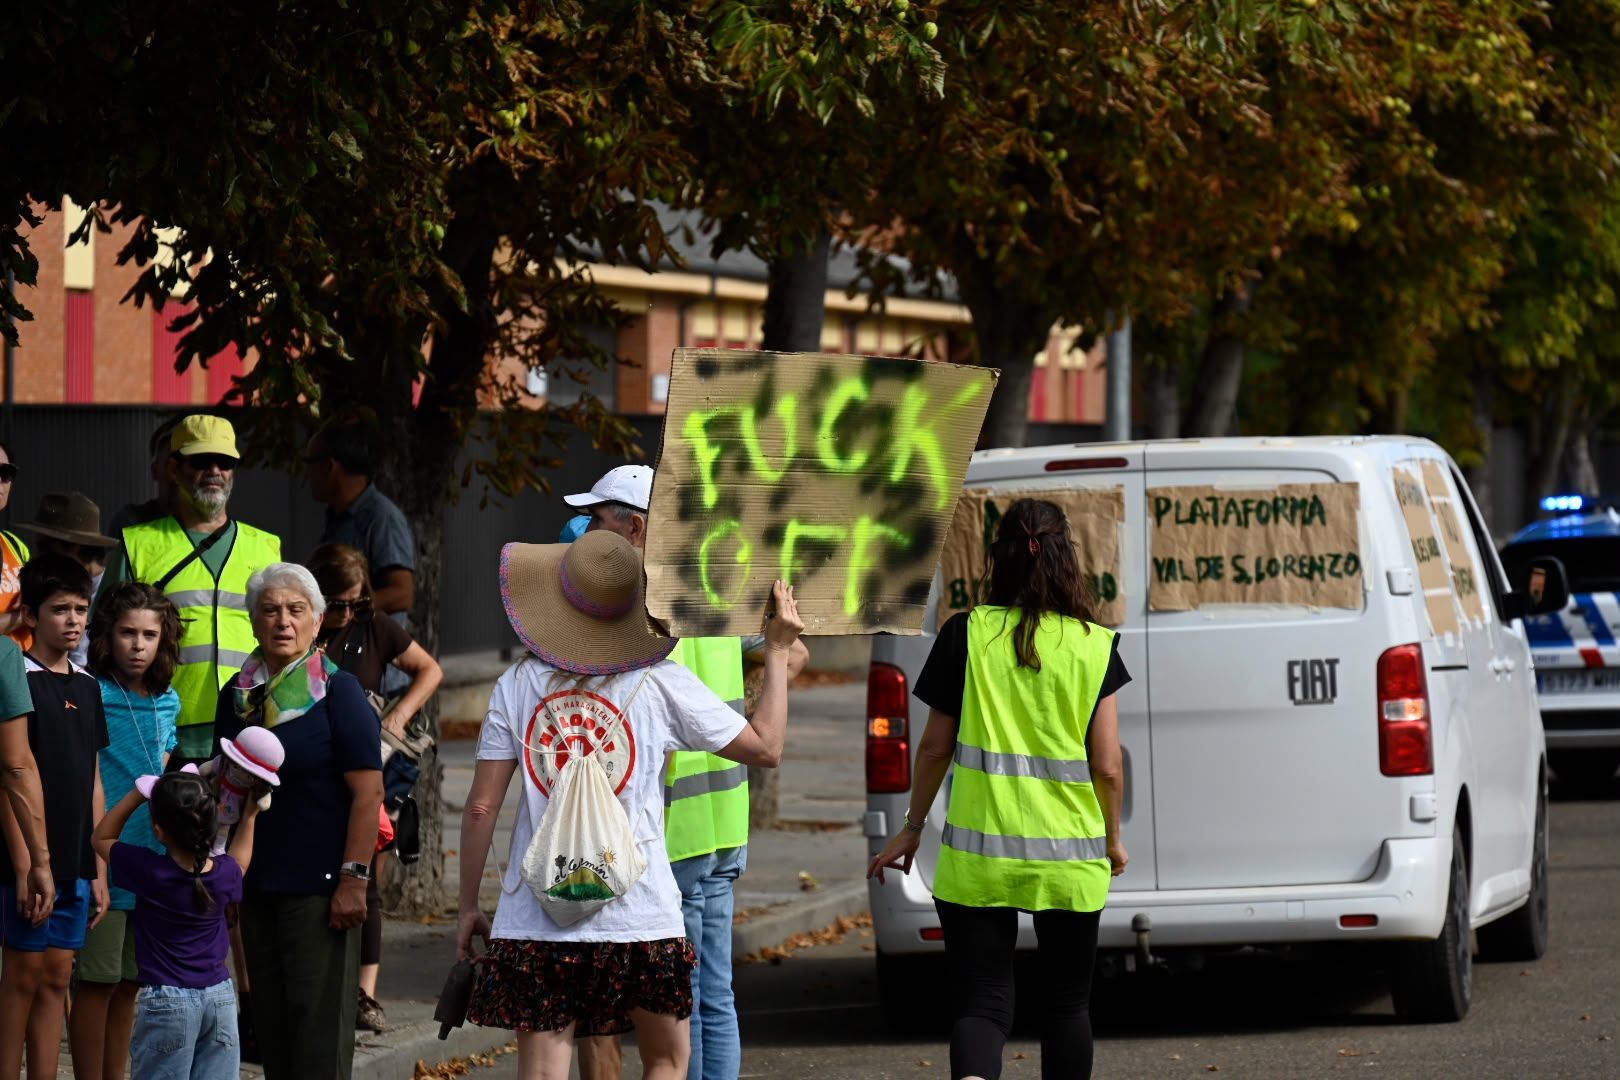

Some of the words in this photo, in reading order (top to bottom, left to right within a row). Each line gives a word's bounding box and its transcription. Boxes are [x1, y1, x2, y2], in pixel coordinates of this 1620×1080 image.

[682, 375, 984, 511] FUCK
[1154, 494, 1327, 528] PLATAFORMA
[700, 513, 911, 617] OFF
[1287, 658, 1340, 705] FIAT
